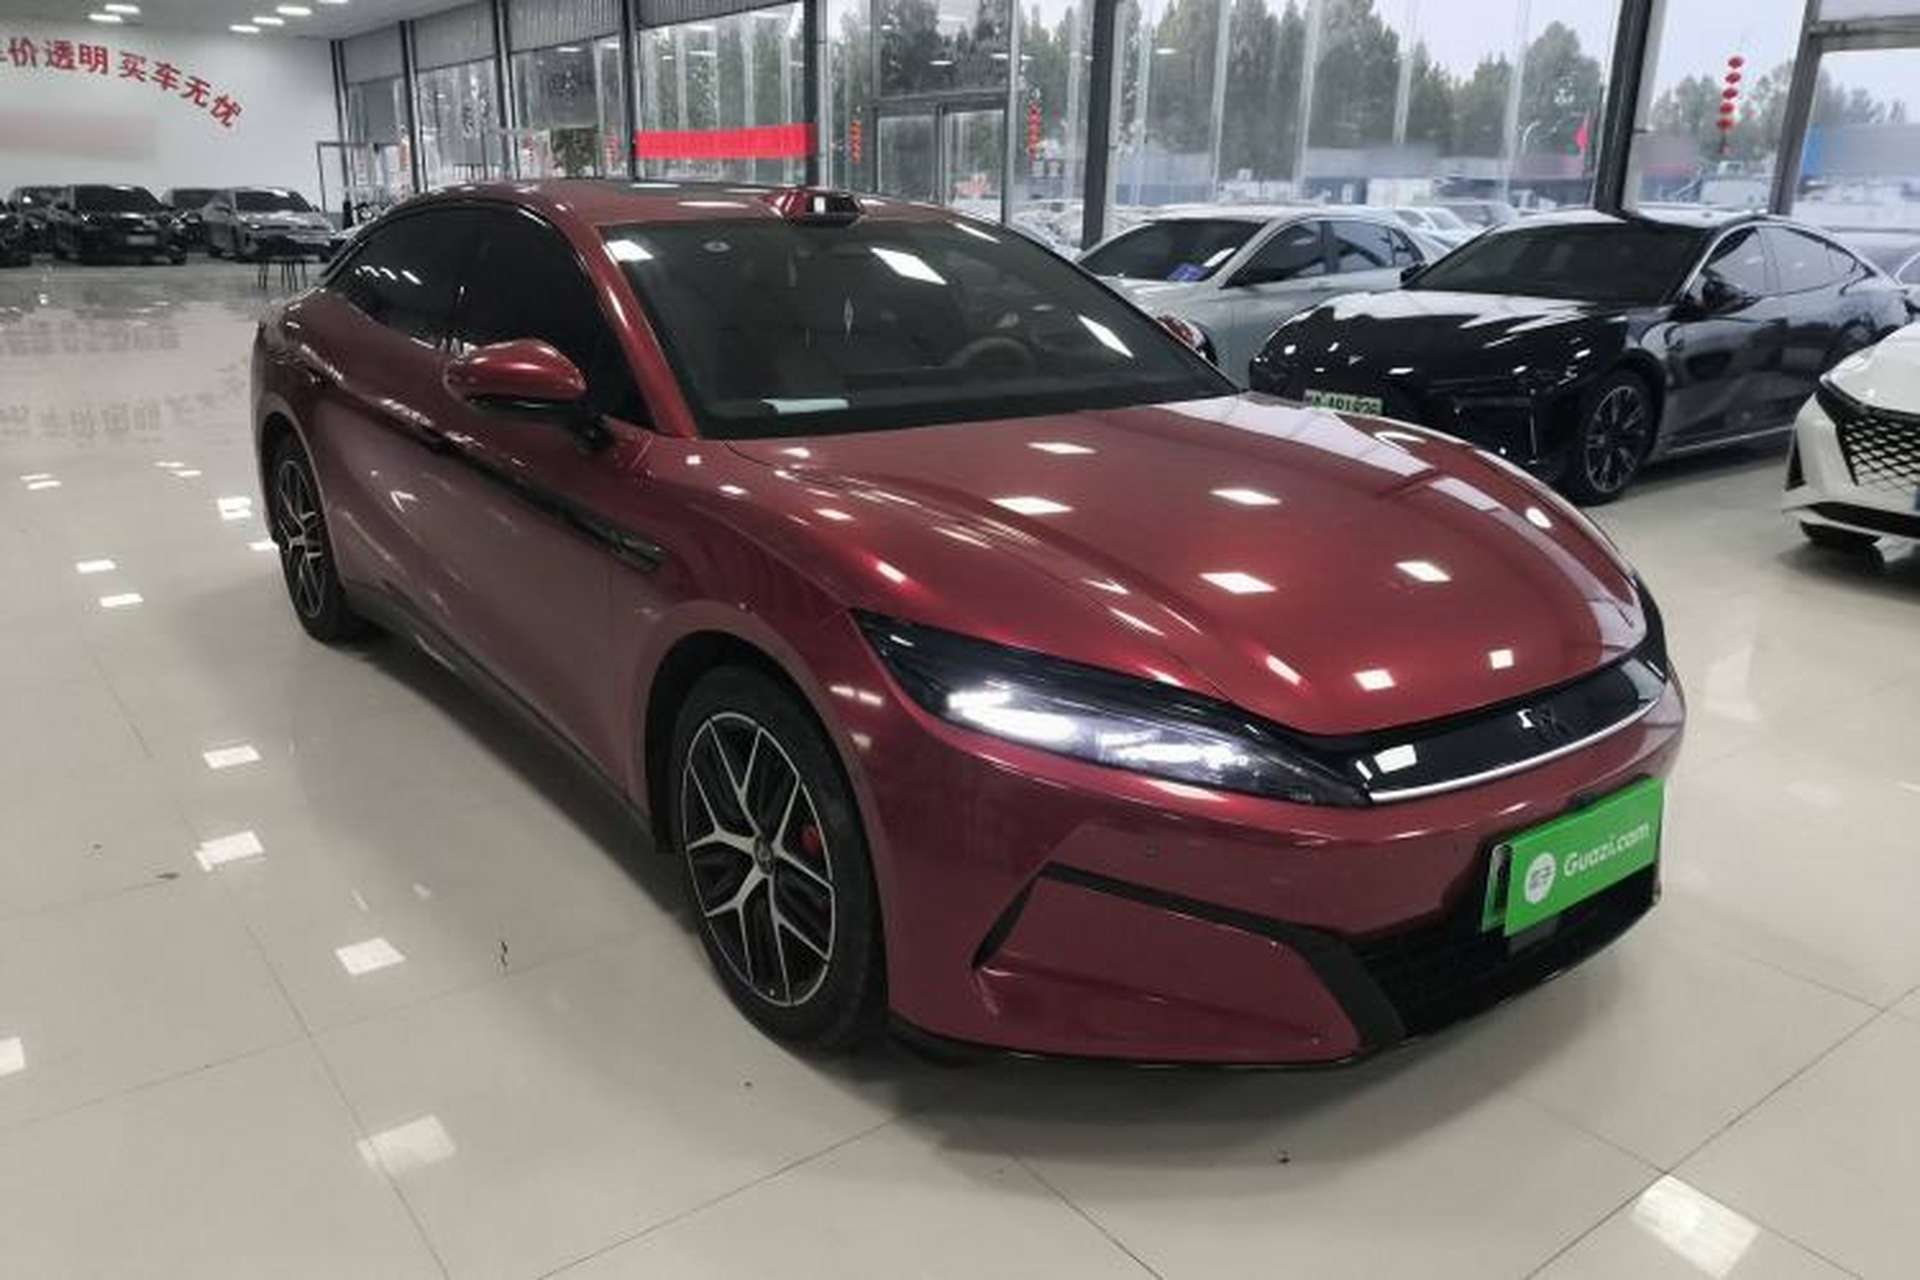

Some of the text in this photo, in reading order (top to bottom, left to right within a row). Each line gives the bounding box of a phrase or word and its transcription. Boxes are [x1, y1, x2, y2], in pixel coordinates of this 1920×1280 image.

[0, 38, 242, 127] 价透明 买车无忧
[1563, 823, 1649, 877] Guazi.com
